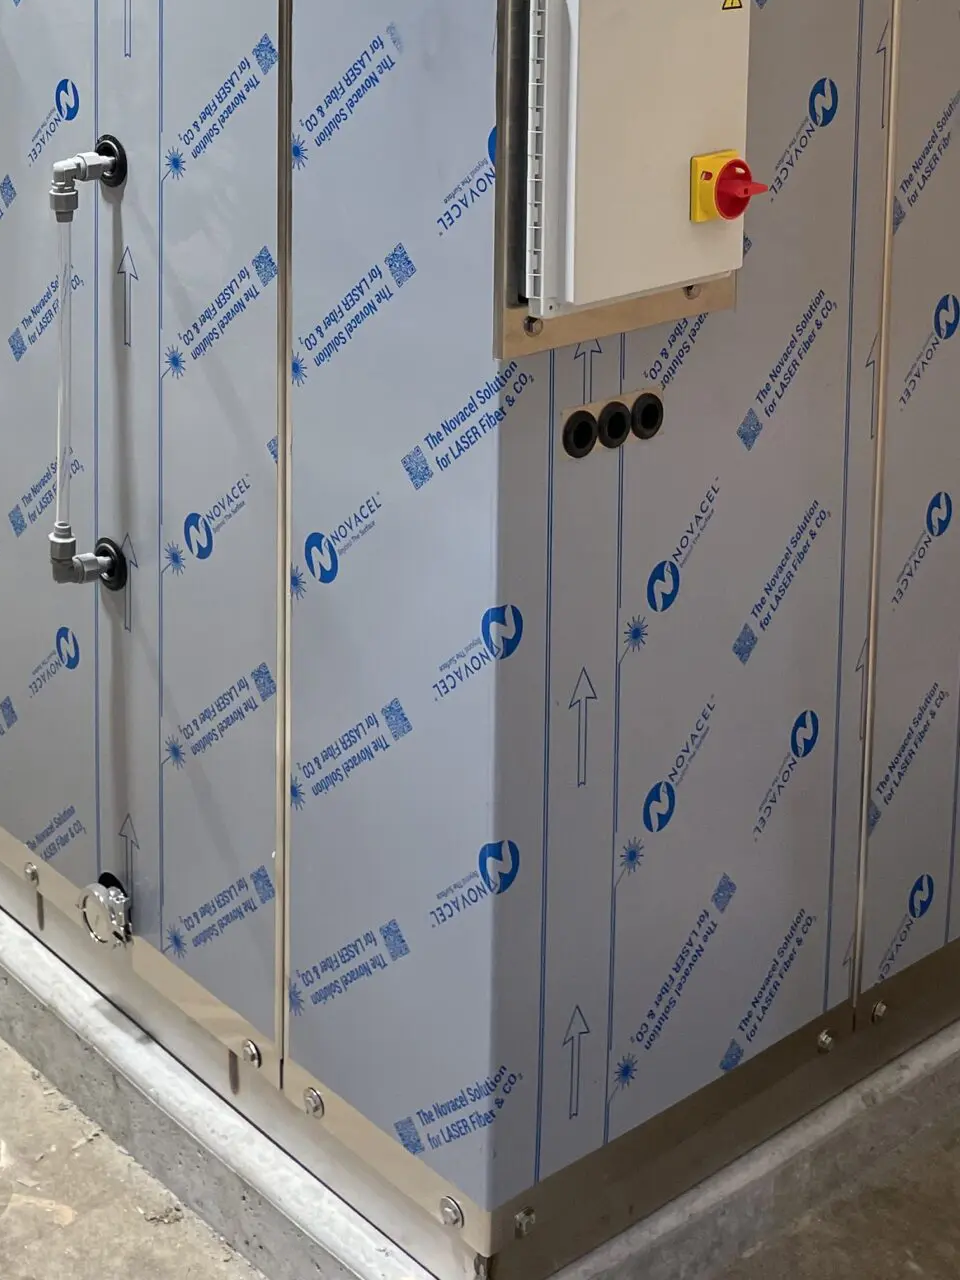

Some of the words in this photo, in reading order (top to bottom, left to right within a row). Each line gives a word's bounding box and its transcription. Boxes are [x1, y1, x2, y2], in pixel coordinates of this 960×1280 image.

[369, 35, 384, 54] for
[238, 57, 250, 74] for
[342, 50, 372, 86] LASER
[376, 54, 395, 74] The
[214, 70, 240, 103] LASER
[244, 74, 260, 92] The
[323, 81, 345, 109] Fiber
[345, 71, 379, 114] Novacel
[199, 99, 217, 124] Fiber
[217, 89, 246, 129] Novacel
[315, 105, 325, 117] &
[28, 113, 62, 162] NOVACEL
[191, 123, 220, 159] Solution
[192, 120, 200, 132] &
[314, 108, 348, 147] Solution
[770, 123, 816, 194] NOVACEL
[237, 266, 250, 283] for
[368, 264, 382, 283] for
[30, 288, 52, 319] Novacel
[214, 278, 239, 309] LASER
[243, 284, 260, 301] The
[341, 277, 370, 311] LASER
[374, 284, 393, 303] The
[191, 322, 200, 334] &
[198, 303, 217, 326] Fiber
[217, 297, 246, 334] Novacel
[322, 304, 344, 330] Fiber
[344, 299, 378, 339] Novacel
[191, 327, 219, 360] Solution
[314, 325, 324, 338] &
[755, 382, 771, 404] The
[769, 333, 797, 383] Novacel
[795, 289, 824, 336] Solution
[313, 331, 347, 366] Solution
[764, 398, 776, 418] for
[774, 359, 800, 399] LASER
[797, 329, 816, 360] Fiber
[814, 319, 823, 330] &
[424, 433, 444, 450] The
[440, 396, 478, 436] Novacel
[476, 360, 518, 404] Solution
[436, 453, 451, 471] for
[448, 426, 482, 460] LASER
[478, 406, 507, 434] Fiber
[505, 395, 516, 407] &
[205, 478, 250, 526] NOVACEL
[330, 496, 382, 546] NOVACEL
[672, 484, 720, 562] NOVACEL
[750, 596, 766, 618] The
[764, 546, 792, 596] Novacel
[790, 500, 818, 548] Solution
[759, 611, 771, 631] for
[769, 570, 794, 612] LASER
[791, 539, 810, 571] Fiber
[809, 529, 817, 539] &
[236, 676, 249, 692] for
[432, 646, 493, 697] NOVACEL
[214, 685, 239, 712] LASER
[242, 696, 259, 712] The
[198, 704, 217, 724] Fiber
[216, 706, 245, 737] Novacel
[364, 712, 379, 729] for
[190, 728, 219, 755] Solution
[338, 722, 367, 750] LASER
[371, 734, 390, 751] The
[668, 702, 716, 782] NOVACEL
[312, 756, 322, 770] &
[320, 741, 341, 762] Fiber
[341, 745, 374, 778] Novacel
[311, 768, 344, 796] Solution
[697, 909, 709, 929] for
[702, 920, 718, 942] The
[337, 938, 365, 964] LASER
[363, 930, 377, 946] for
[672, 929, 698, 973] LASER
[319, 953, 340, 973] Fiber
[340, 961, 372, 991] Novacel
[369, 953, 388, 970] The
[674, 944, 704, 997] Novacel
[737, 1010, 753, 1032] The
[751, 957, 779, 1009] Novacel
[777, 908, 805, 958] Solution
[310, 980, 342, 1005] Solution
[654, 973, 674, 1008] Fiber
[746, 1022, 757, 1042] for
[756, 980, 780, 1022] LASER
[778, 947, 796, 979] Fiber
[644, 996, 676, 1050] Solution
